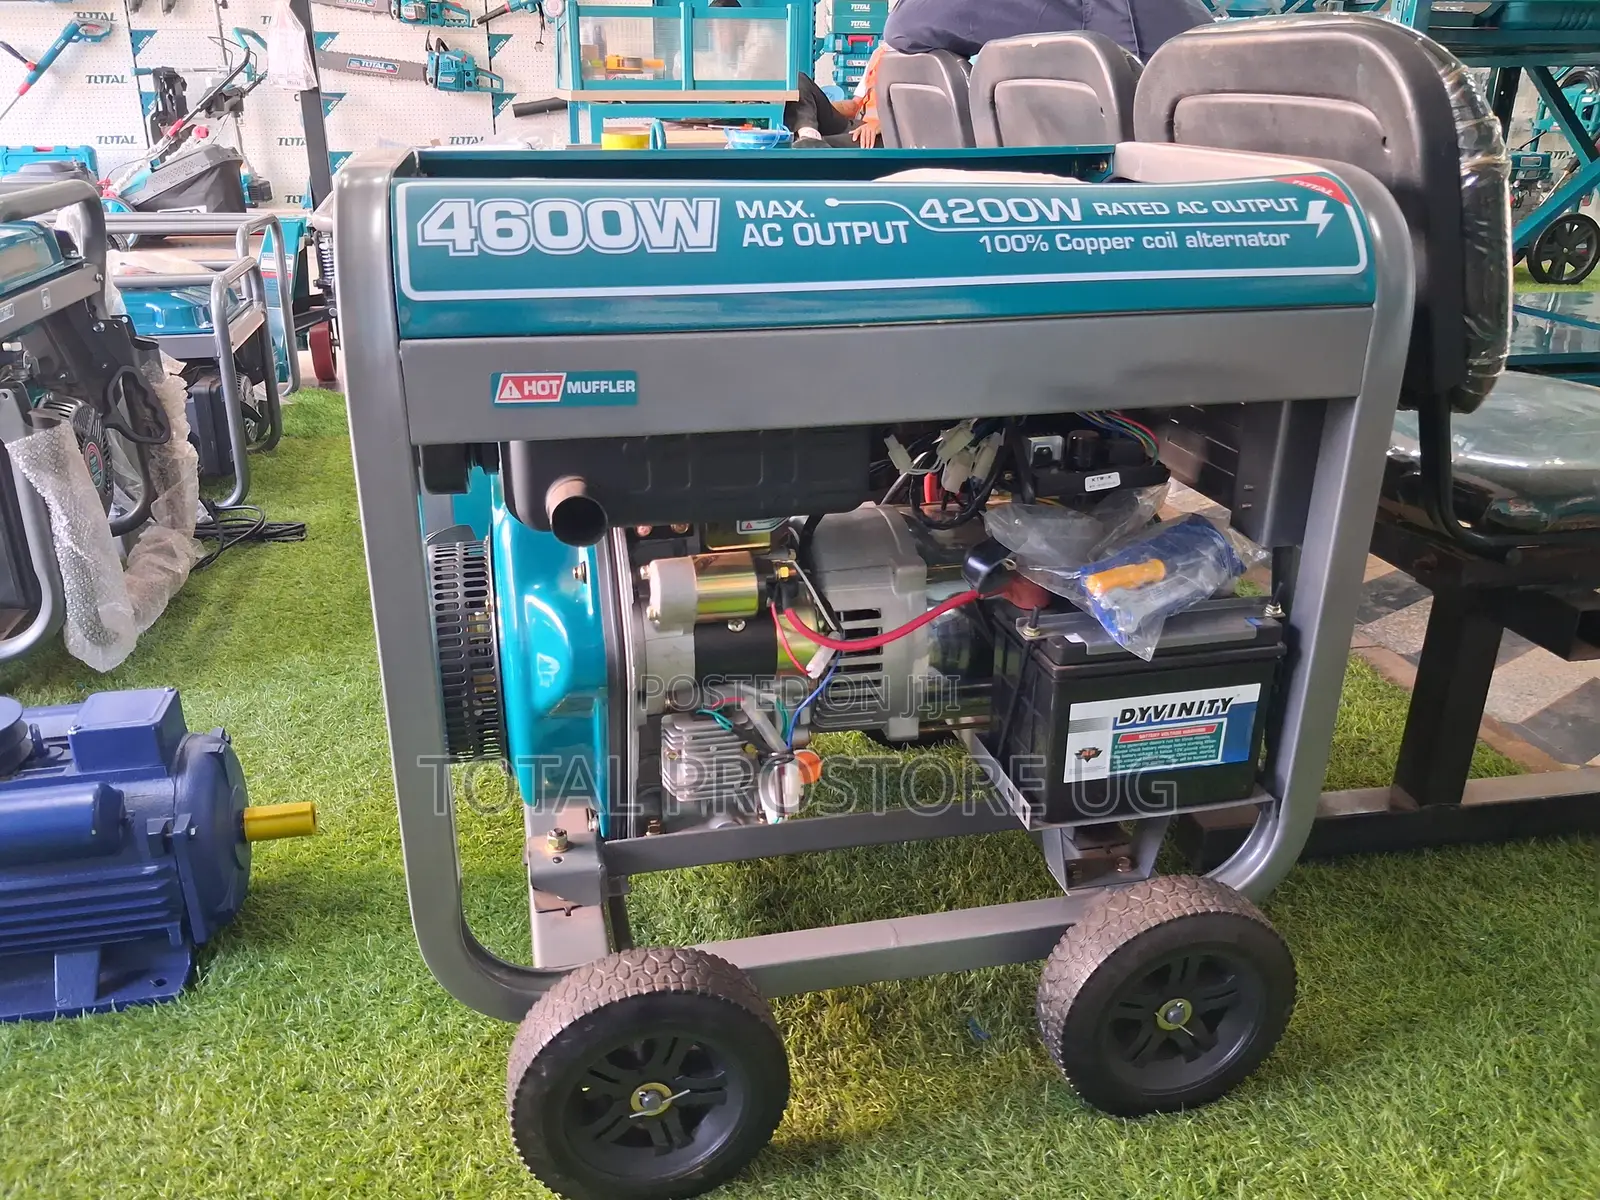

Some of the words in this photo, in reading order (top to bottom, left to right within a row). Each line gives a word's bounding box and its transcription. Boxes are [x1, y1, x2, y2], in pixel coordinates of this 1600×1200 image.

[74, 11, 118, 22] TOTAL
[361, 60, 385, 69] TOTAL
[85, 74, 128, 84] TOTAL
[96, 135, 138, 145] TOTAL
[277, 137, 306, 146] TOT
[735, 200, 815, 219] MAX.
[919, 196, 1083, 225] 4200W
[1092, 200, 1170, 217] RATED
[1177, 199, 1209, 216] AC
[1211, 196, 1300, 215] OUTPUT
[417, 196, 721, 256] 4600W
[742, 222, 784, 248] AC
[793, 220, 910, 247] OUTPUT
[978, 233, 1050, 254] 100%
[1055, 232, 1135, 256] Copper
[1142, 230, 1178, 249] coil
[1184, 230, 1291, 249] alternator
[523, 380, 561, 396] HOT
[566, 380, 636, 394] MUFFLER
[1118, 696, 1234, 724] DYVINITY
